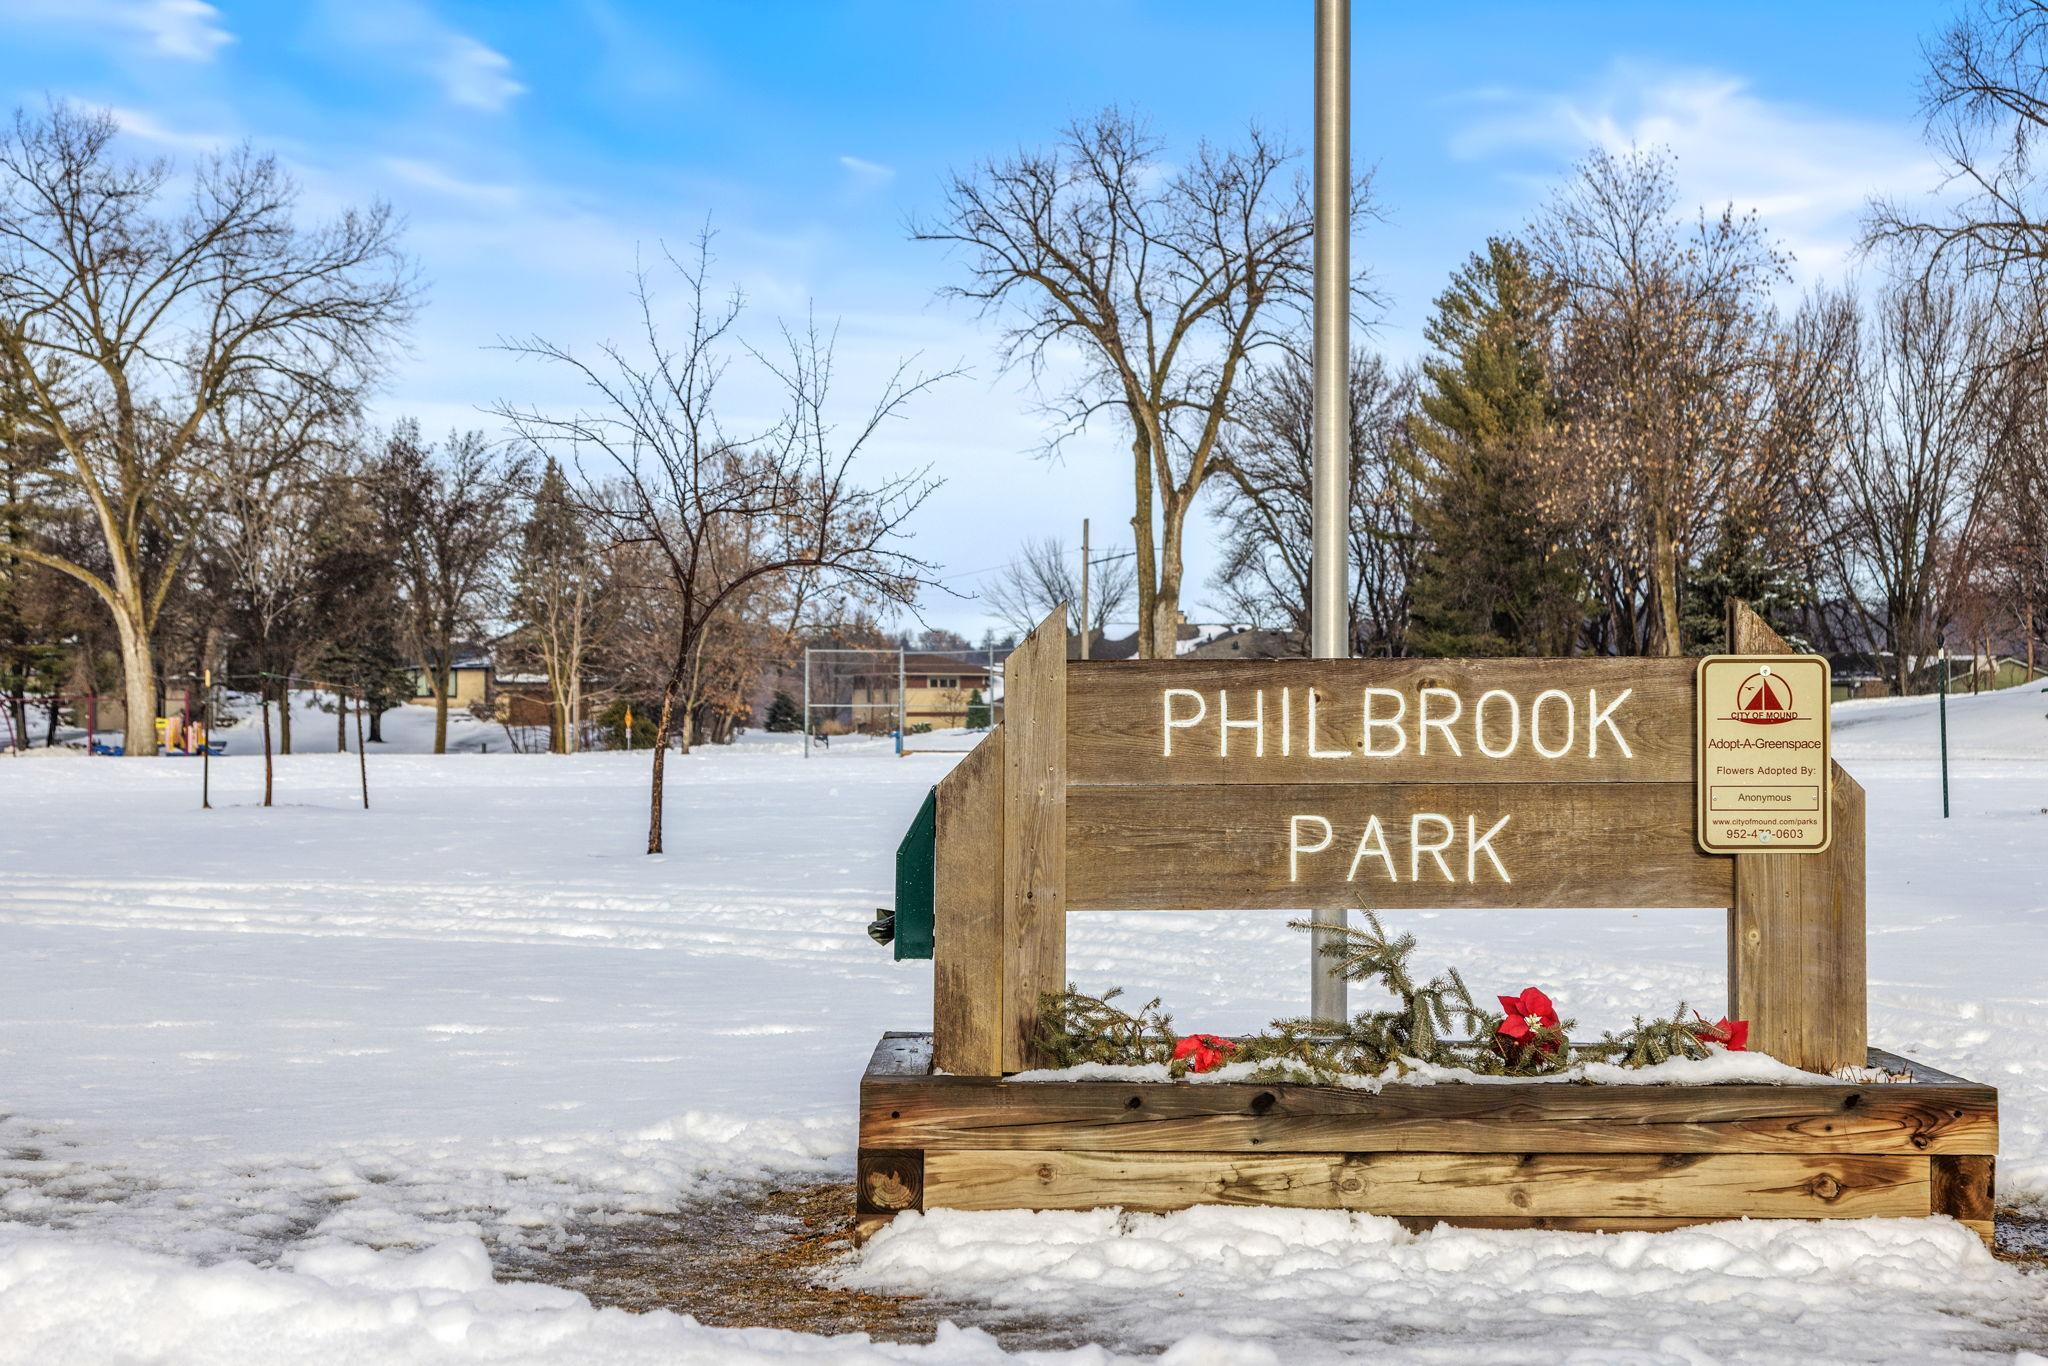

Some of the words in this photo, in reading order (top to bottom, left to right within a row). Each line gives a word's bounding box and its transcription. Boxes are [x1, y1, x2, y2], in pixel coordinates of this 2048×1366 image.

[1163, 687, 1634, 759] PHILBROOK
[1708, 738, 1821, 751] Adopt-A-Greenspace
[1717, 766, 1754, 775] Flowers
[1757, 766, 1798, 776] Adopted
[1800, 766, 1816, 777] By:
[1738, 793, 1792, 803] Anonymous
[1712, 818, 1818, 827] www.cityofmound.com/parks
[1289, 814, 1512, 884] PARK
